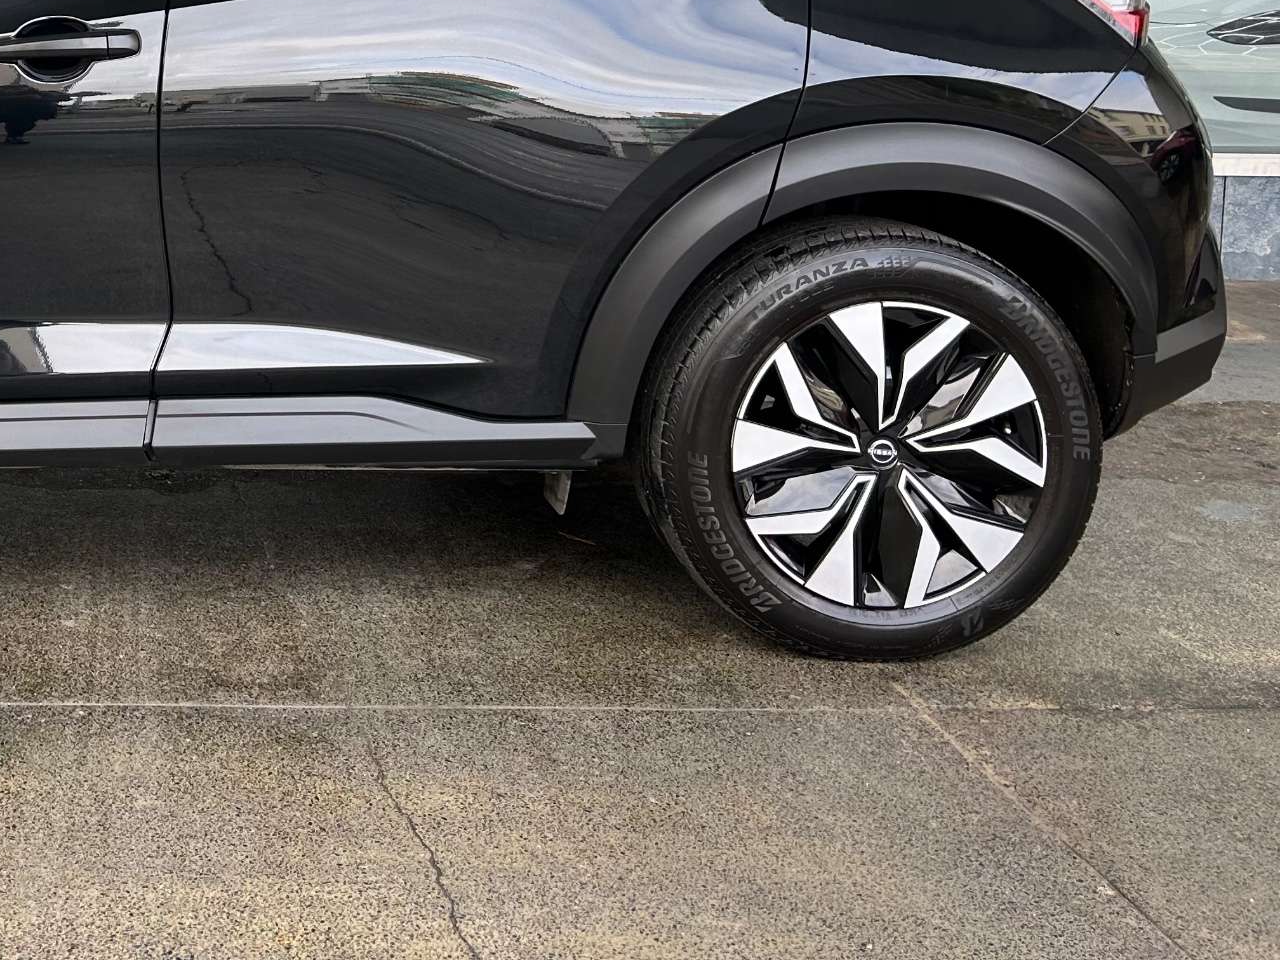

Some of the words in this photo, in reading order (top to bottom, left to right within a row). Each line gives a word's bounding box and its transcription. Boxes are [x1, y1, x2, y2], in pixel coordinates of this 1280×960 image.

[745, 257, 869, 321] TURANZA
[998, 295, 1091, 461] BRIDGESTONE
[687, 451, 783, 613] BRIDGESTONE
